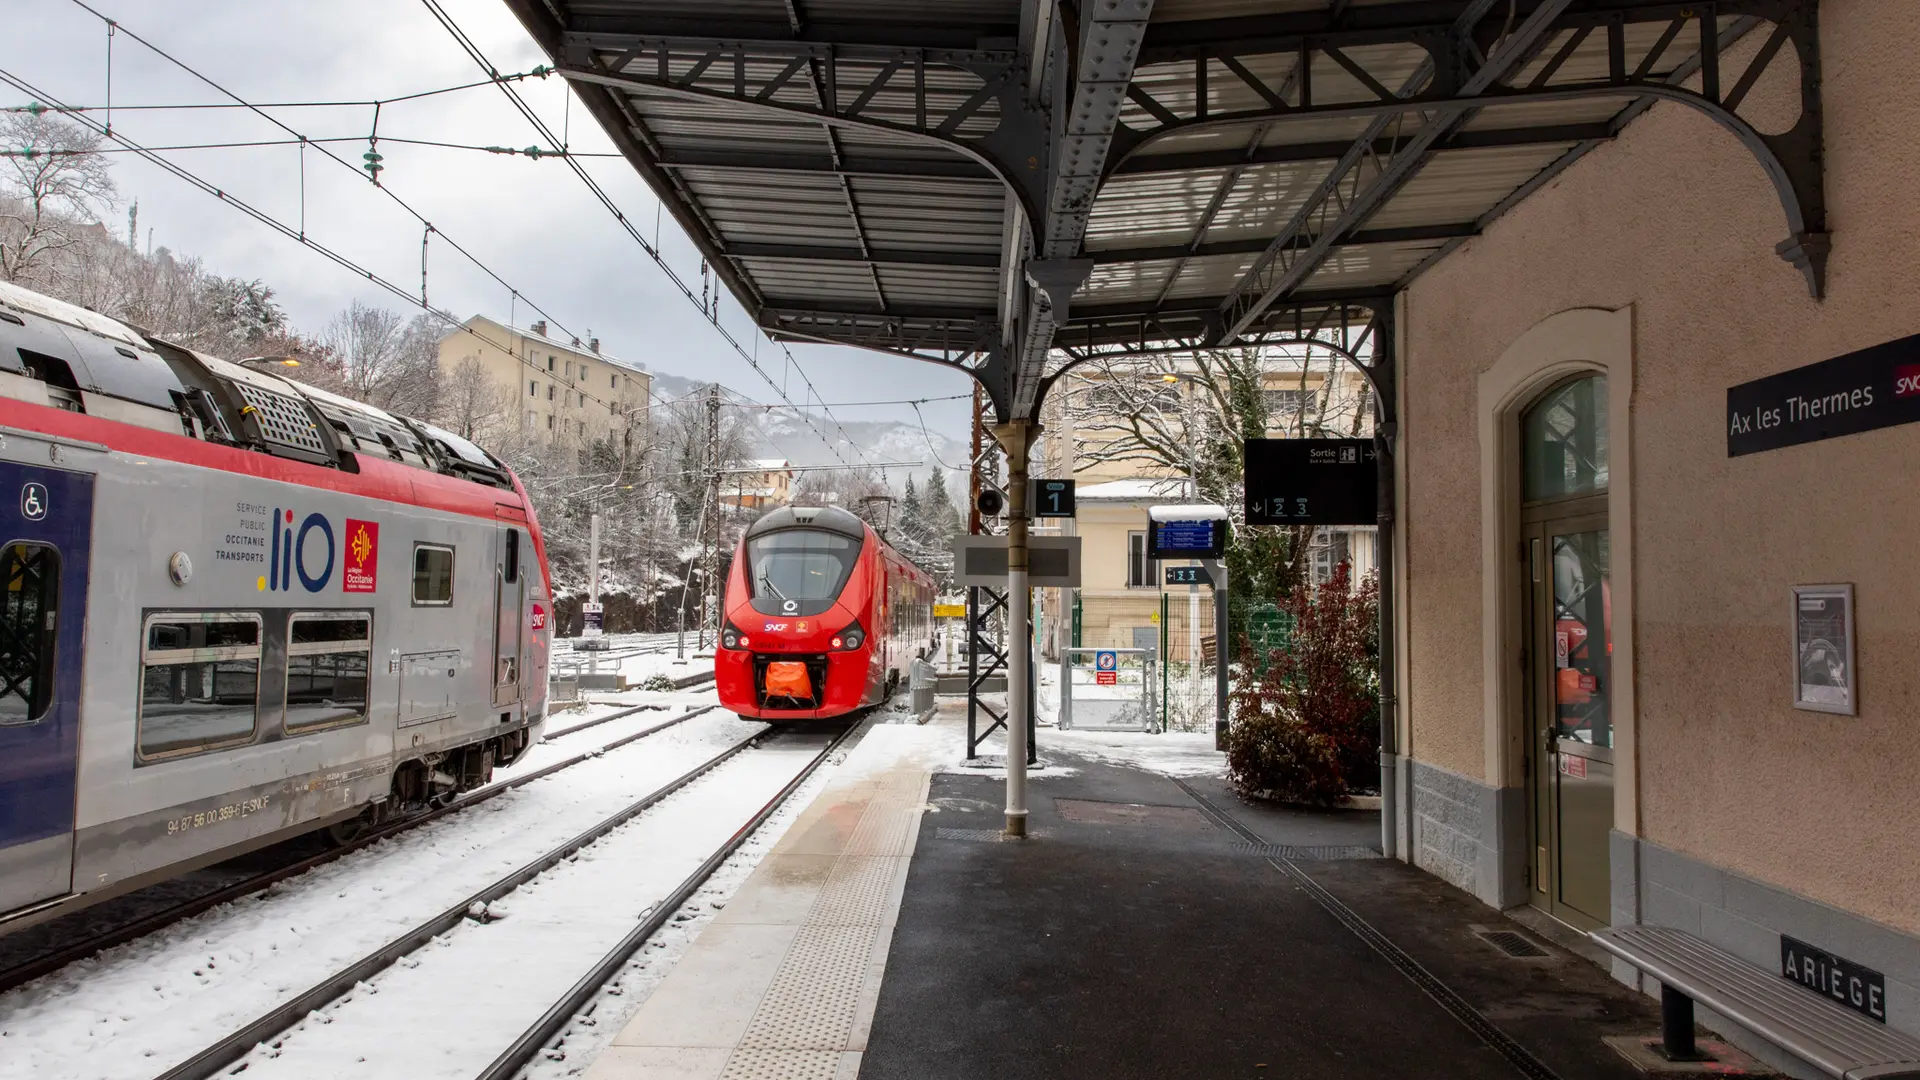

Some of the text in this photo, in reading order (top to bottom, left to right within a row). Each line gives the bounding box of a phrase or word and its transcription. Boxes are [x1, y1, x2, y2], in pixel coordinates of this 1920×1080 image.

[1730, 385, 1873, 436] Ax les Thermes
[1310, 448, 1336, 457] Sortie
[236, 502, 266, 515] SERVICE
[1048, 492, 1059, 512] 1
[1275, 503, 1306, 515] 2 3
[240, 519, 266, 531] PUBLIC
[225, 534, 264, 547] OCCITANIE
[215, 550, 264, 563] TRANSPORTS
[347, 573, 373, 584] Occitanie
[764, 623, 788, 632] SNCF
[167, 820, 179, 835] 94
[181, 816, 193, 831] 87
[194, 813, 205, 827] 56
[206, 810, 217, 824] 00
[218, 804, 241, 821] 359-6
[1786, 950, 1883, 1017] ARIÈGE
